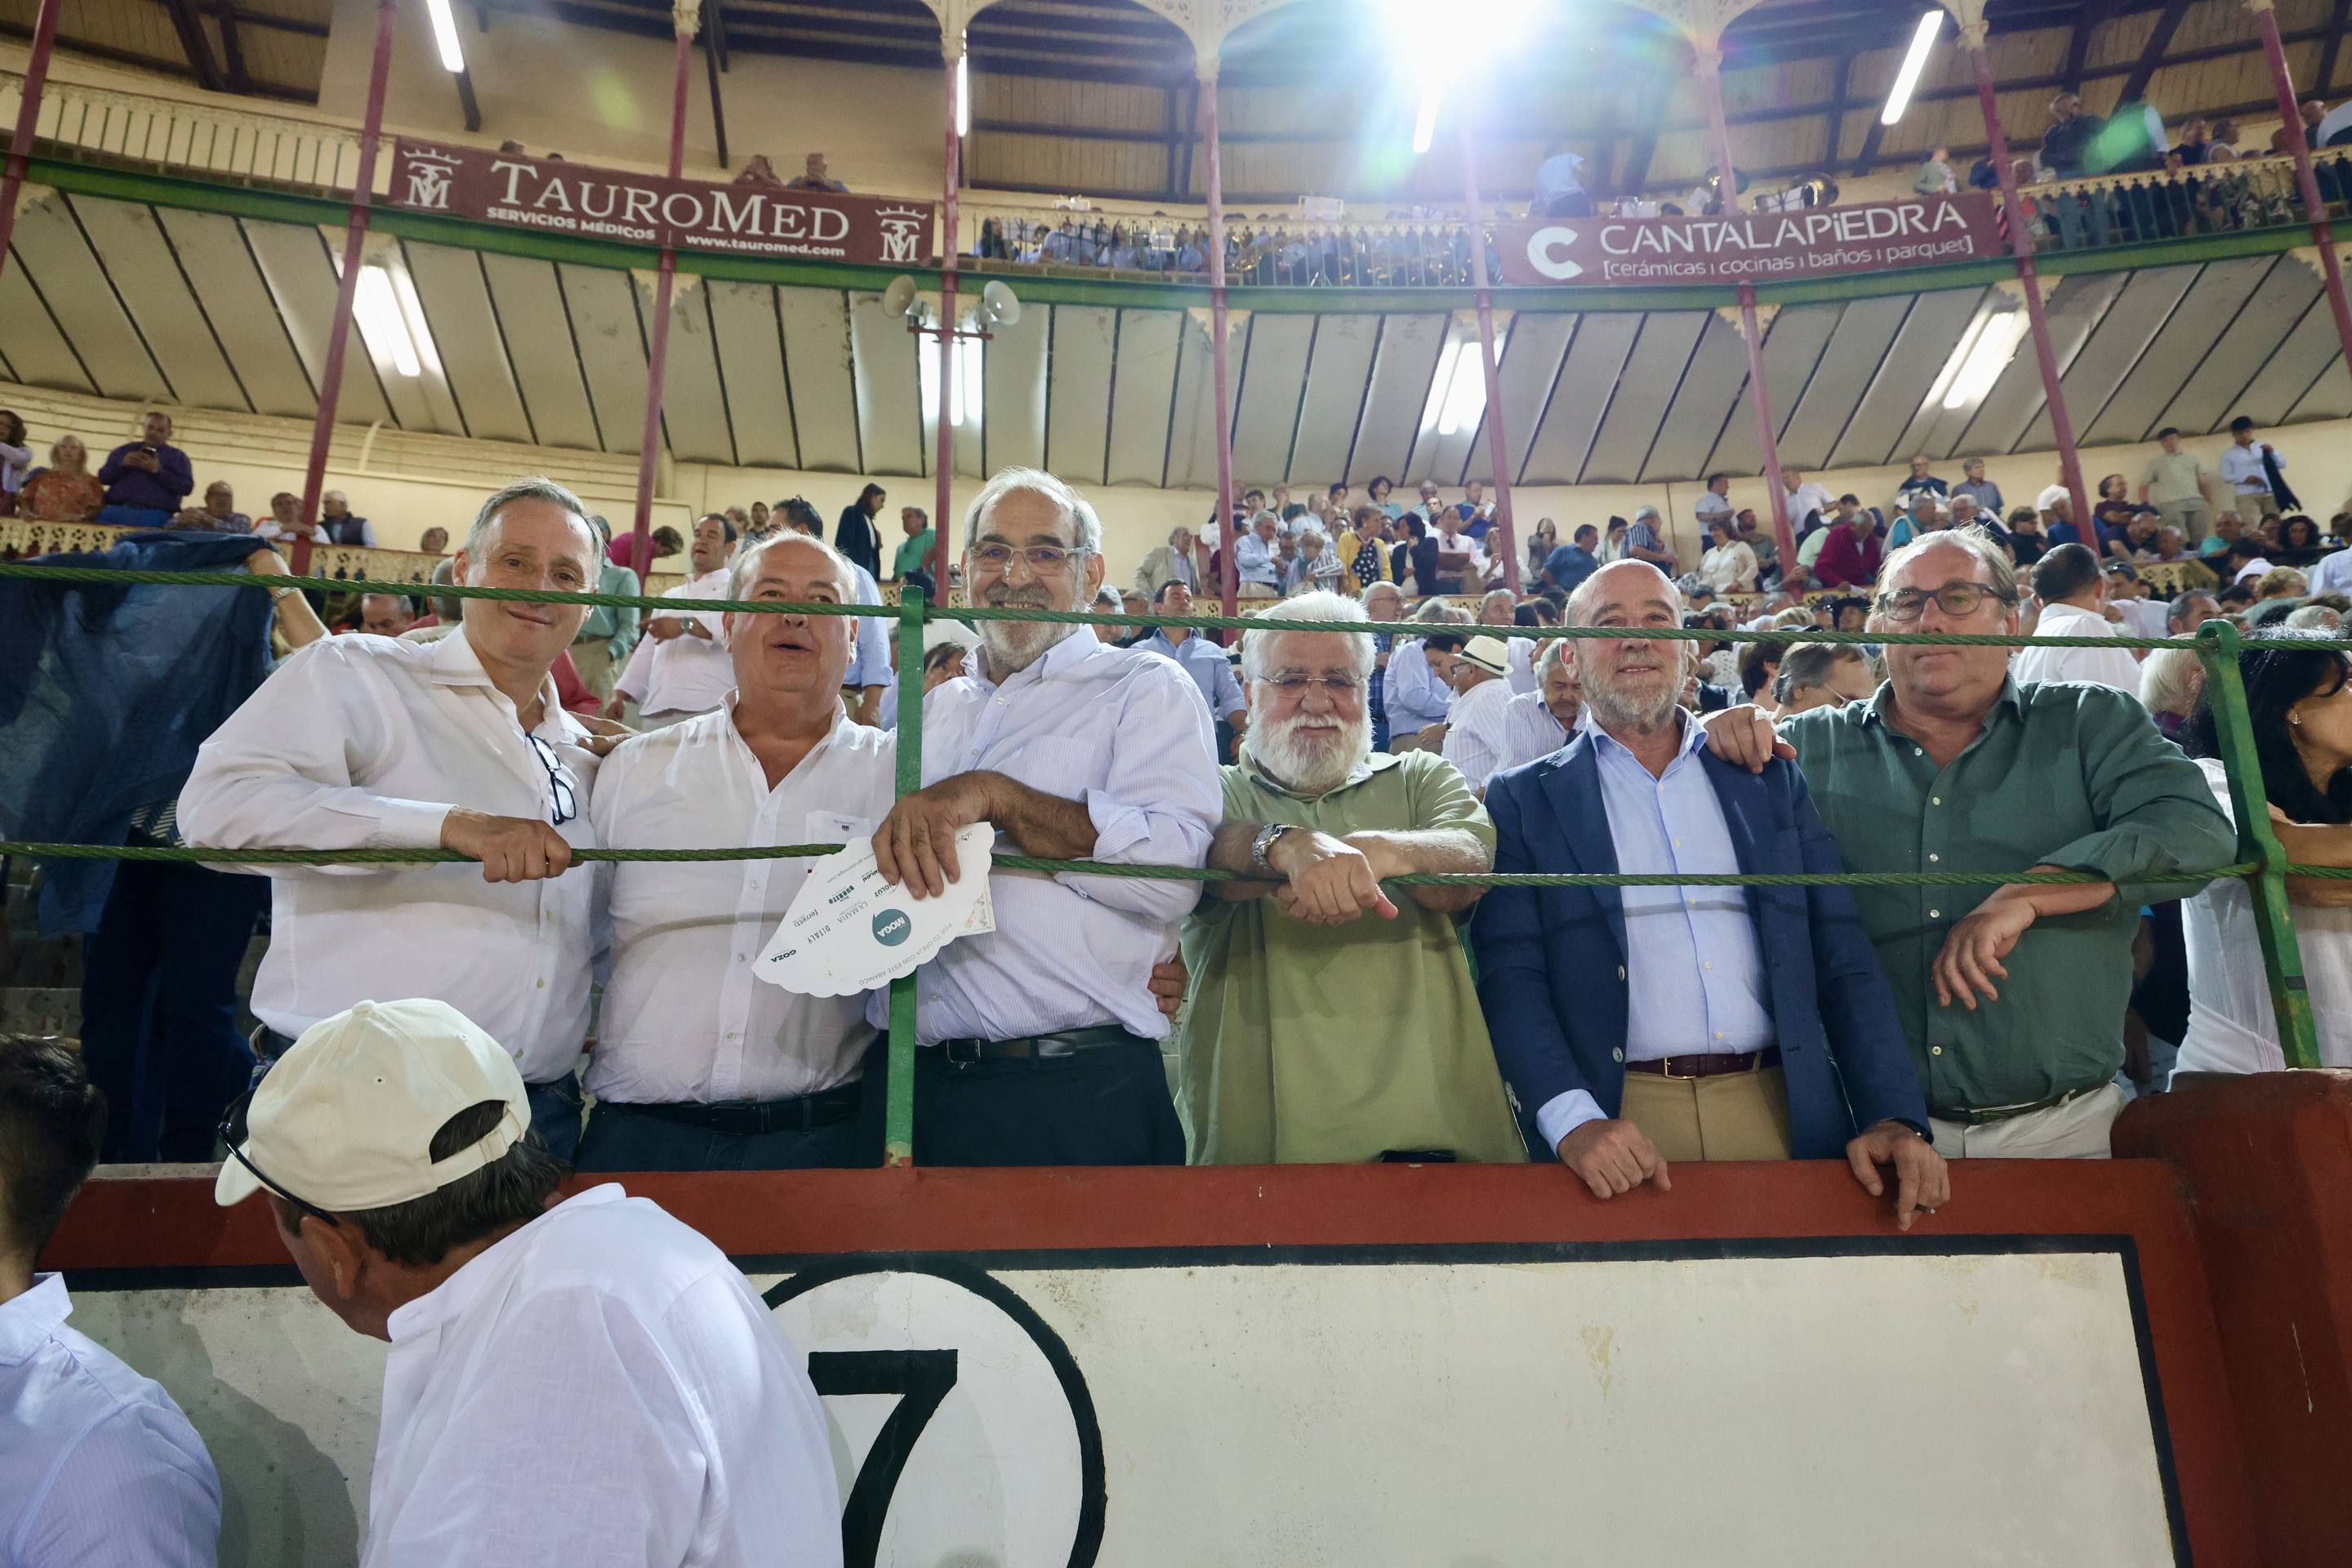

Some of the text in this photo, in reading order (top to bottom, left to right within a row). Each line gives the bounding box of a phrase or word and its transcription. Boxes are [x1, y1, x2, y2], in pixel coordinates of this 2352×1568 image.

[487, 207, 845, 256] SERVICIOS MÉDICOS www.tauromed.com
[1719, 256, 1794, 274] cocinas
[1809, 248, 1872, 269] baños
[877, 916, 906, 938] MOGA
[770, 948, 797, 964] GOZA
[808, 1349, 959, 1568] 7
